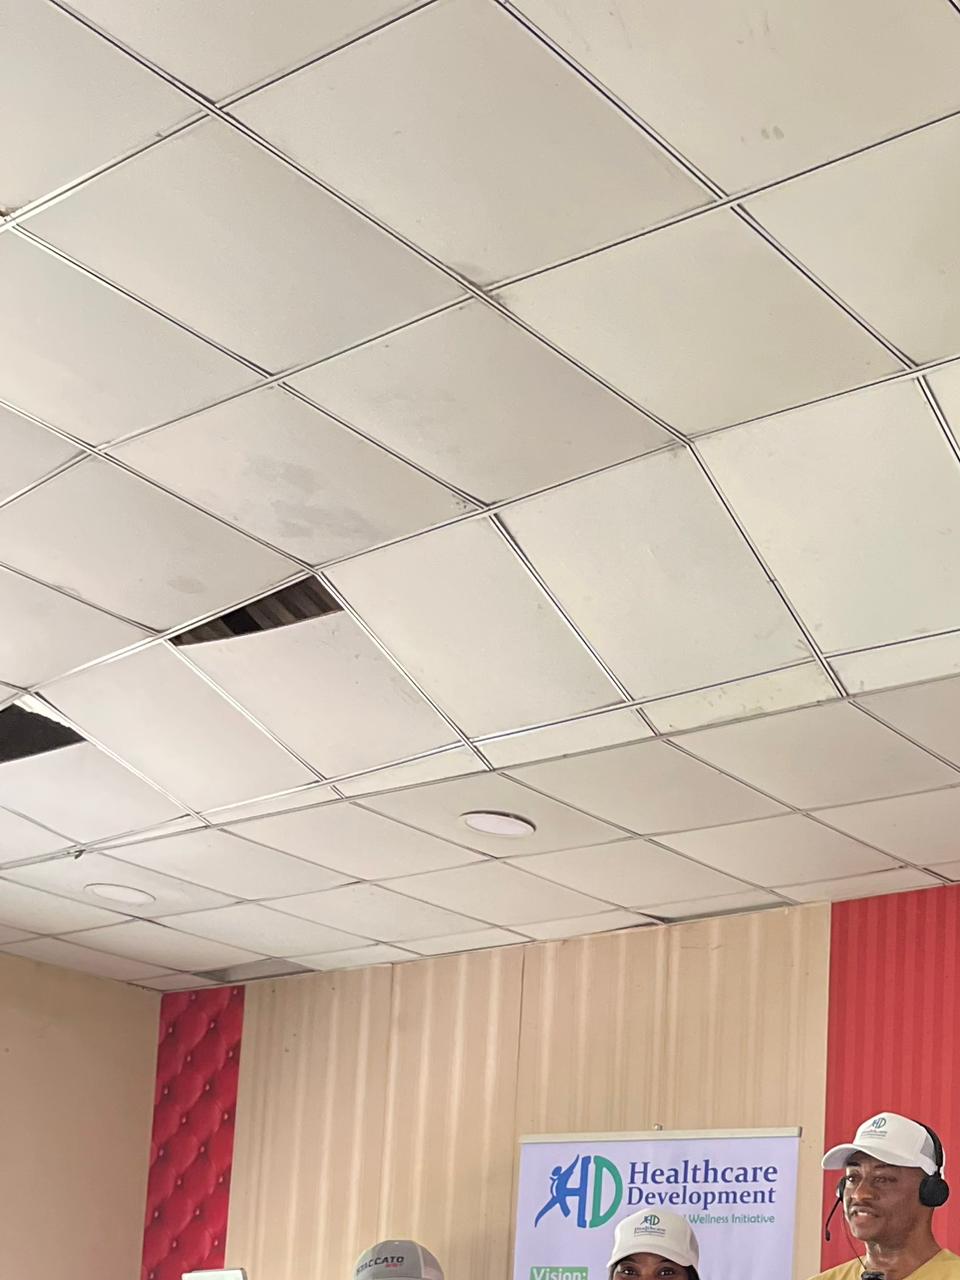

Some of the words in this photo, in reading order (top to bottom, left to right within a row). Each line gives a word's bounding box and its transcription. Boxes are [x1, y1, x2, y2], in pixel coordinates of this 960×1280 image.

[627, 1159, 778, 1185] Healthcare
[627, 1185, 776, 1210] Development
[689, 1214, 729, 1225] Wellness
[731, 1213, 776, 1224] Initiative
